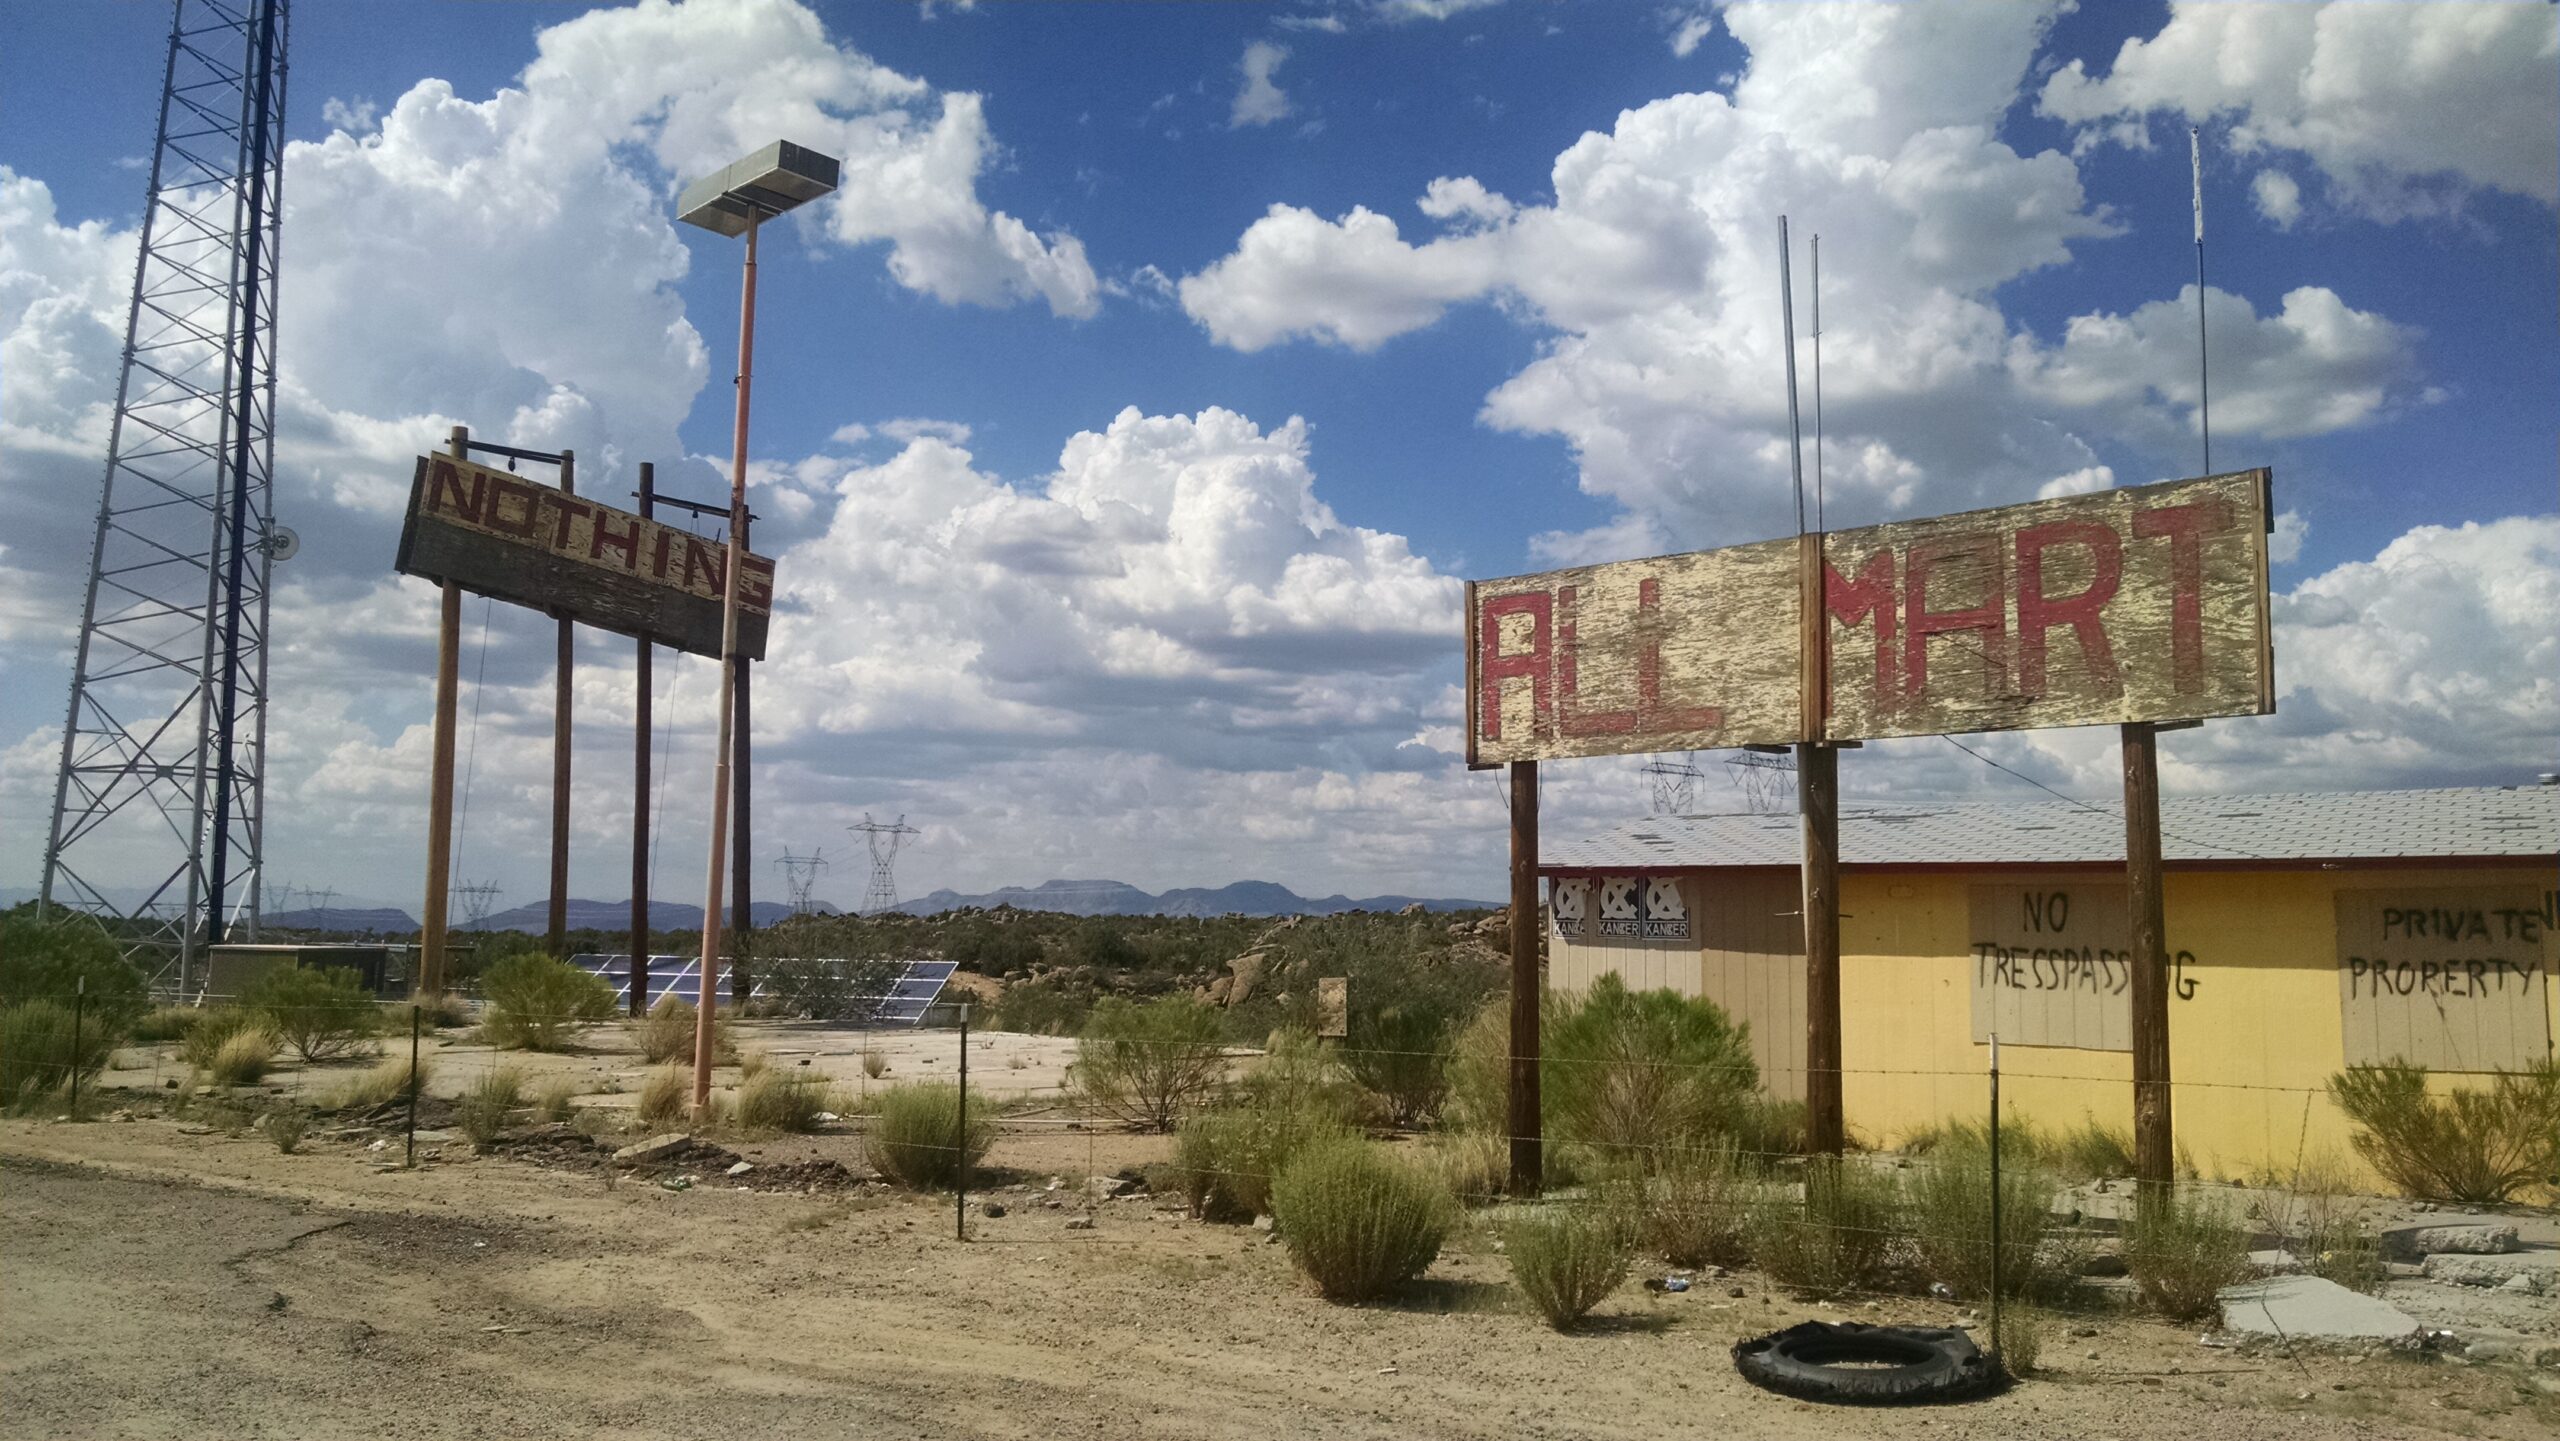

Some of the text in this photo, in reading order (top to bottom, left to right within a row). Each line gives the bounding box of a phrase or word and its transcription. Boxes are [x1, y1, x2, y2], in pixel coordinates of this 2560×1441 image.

[1481, 499, 2235, 742] ALL MART
[2023, 891, 2069, 934] NO
[2383, 907, 2540, 944] PRIVATE
[1971, 941, 2201, 1001] TRESSPASSG
[2349, 955, 2536, 999] PROPERTY
